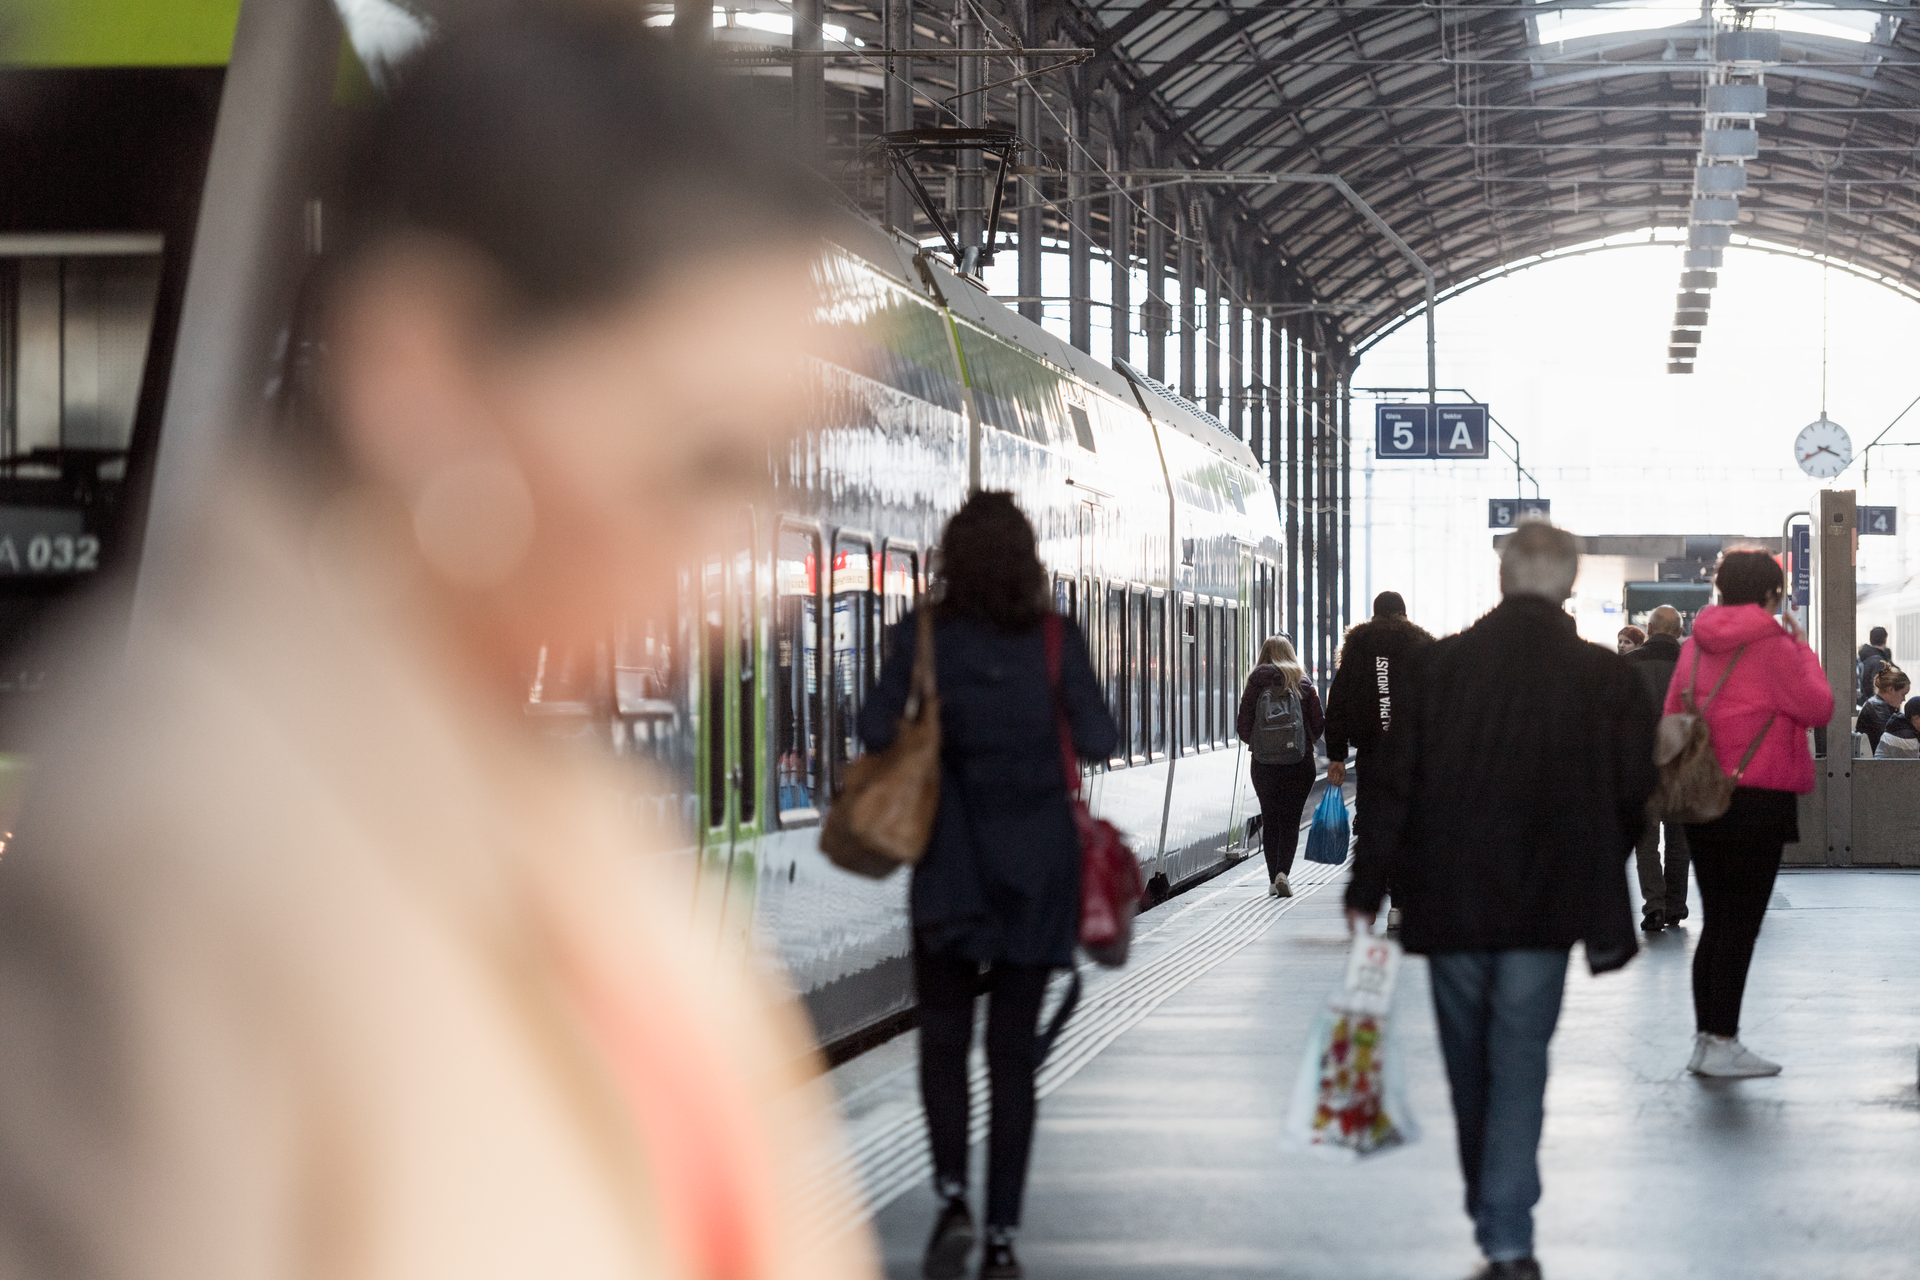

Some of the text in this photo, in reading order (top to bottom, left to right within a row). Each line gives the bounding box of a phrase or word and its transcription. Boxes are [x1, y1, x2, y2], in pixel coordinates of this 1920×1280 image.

[1393, 421, 1415, 450] 5
[1449, 421, 1474, 450] A
[1497, 507, 1510, 525] 5
[1873, 514, 1888, 532] 4
[28, 535, 99, 570] 032
[1379, 696, 1391, 731] ALPHA
